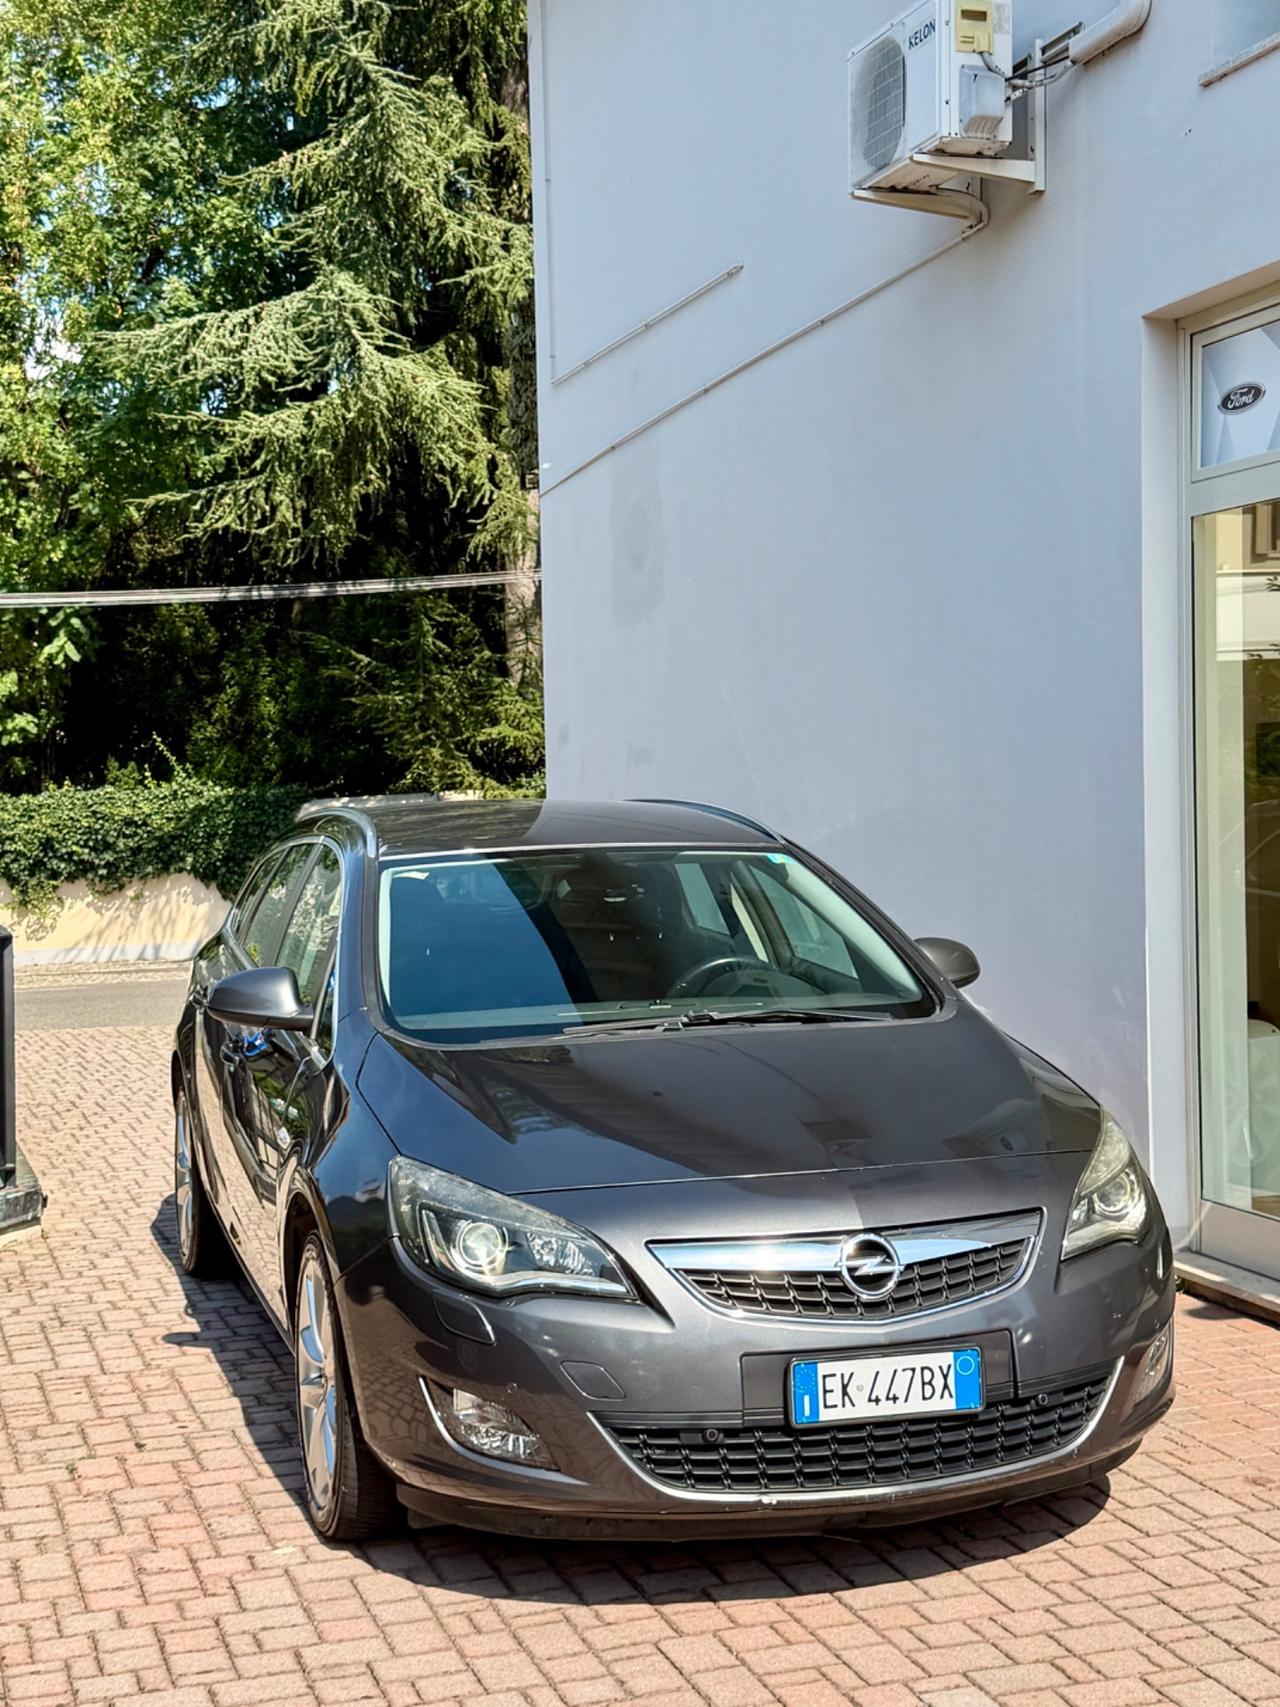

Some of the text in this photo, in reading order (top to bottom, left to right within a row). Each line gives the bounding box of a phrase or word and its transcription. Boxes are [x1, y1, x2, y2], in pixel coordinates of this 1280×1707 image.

[908, 19, 936, 50] KELON
[1227, 387, 1255, 409] Ford
[822, 1364, 954, 1409] EK 447BX
